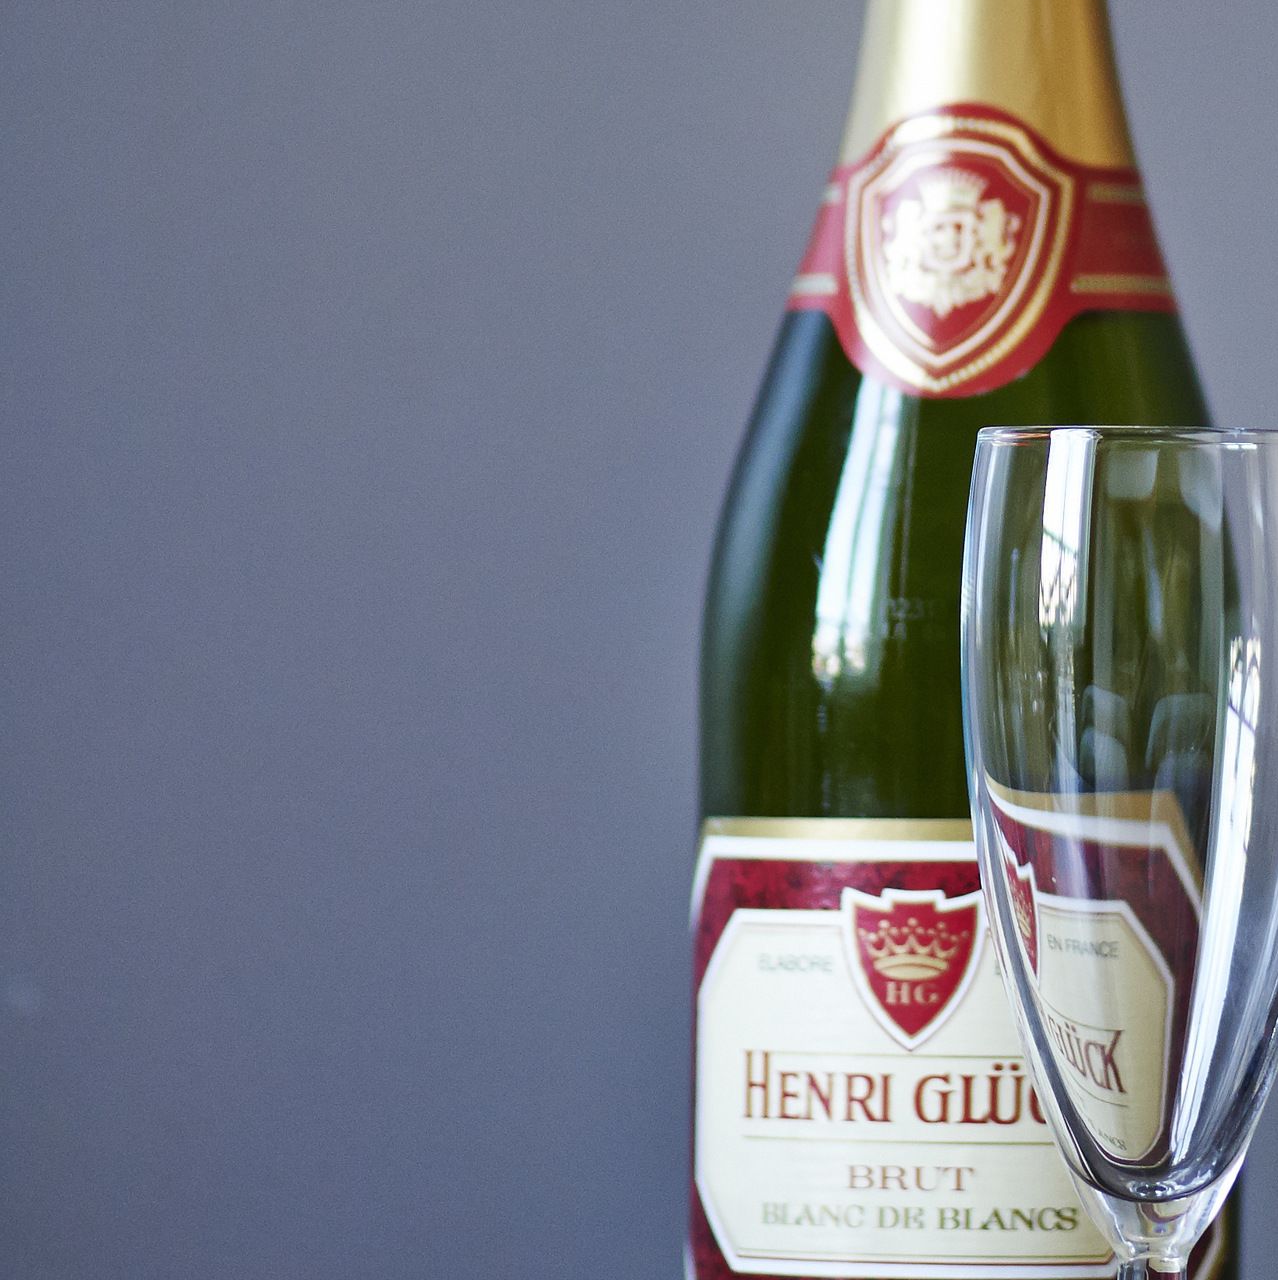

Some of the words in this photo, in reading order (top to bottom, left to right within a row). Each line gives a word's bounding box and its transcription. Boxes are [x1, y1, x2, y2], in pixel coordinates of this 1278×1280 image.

[1064, 937, 1120, 959] FRANCE
[886, 982, 939, 1006] HG
[744, 1049, 896, 1123] HENRI
[848, 1164, 976, 1193] BRUT
[761, 1201, 870, 1228] BLANC
[876, 1205, 924, 1230] DE
[935, 1206, 1079, 1232] BLANCS
